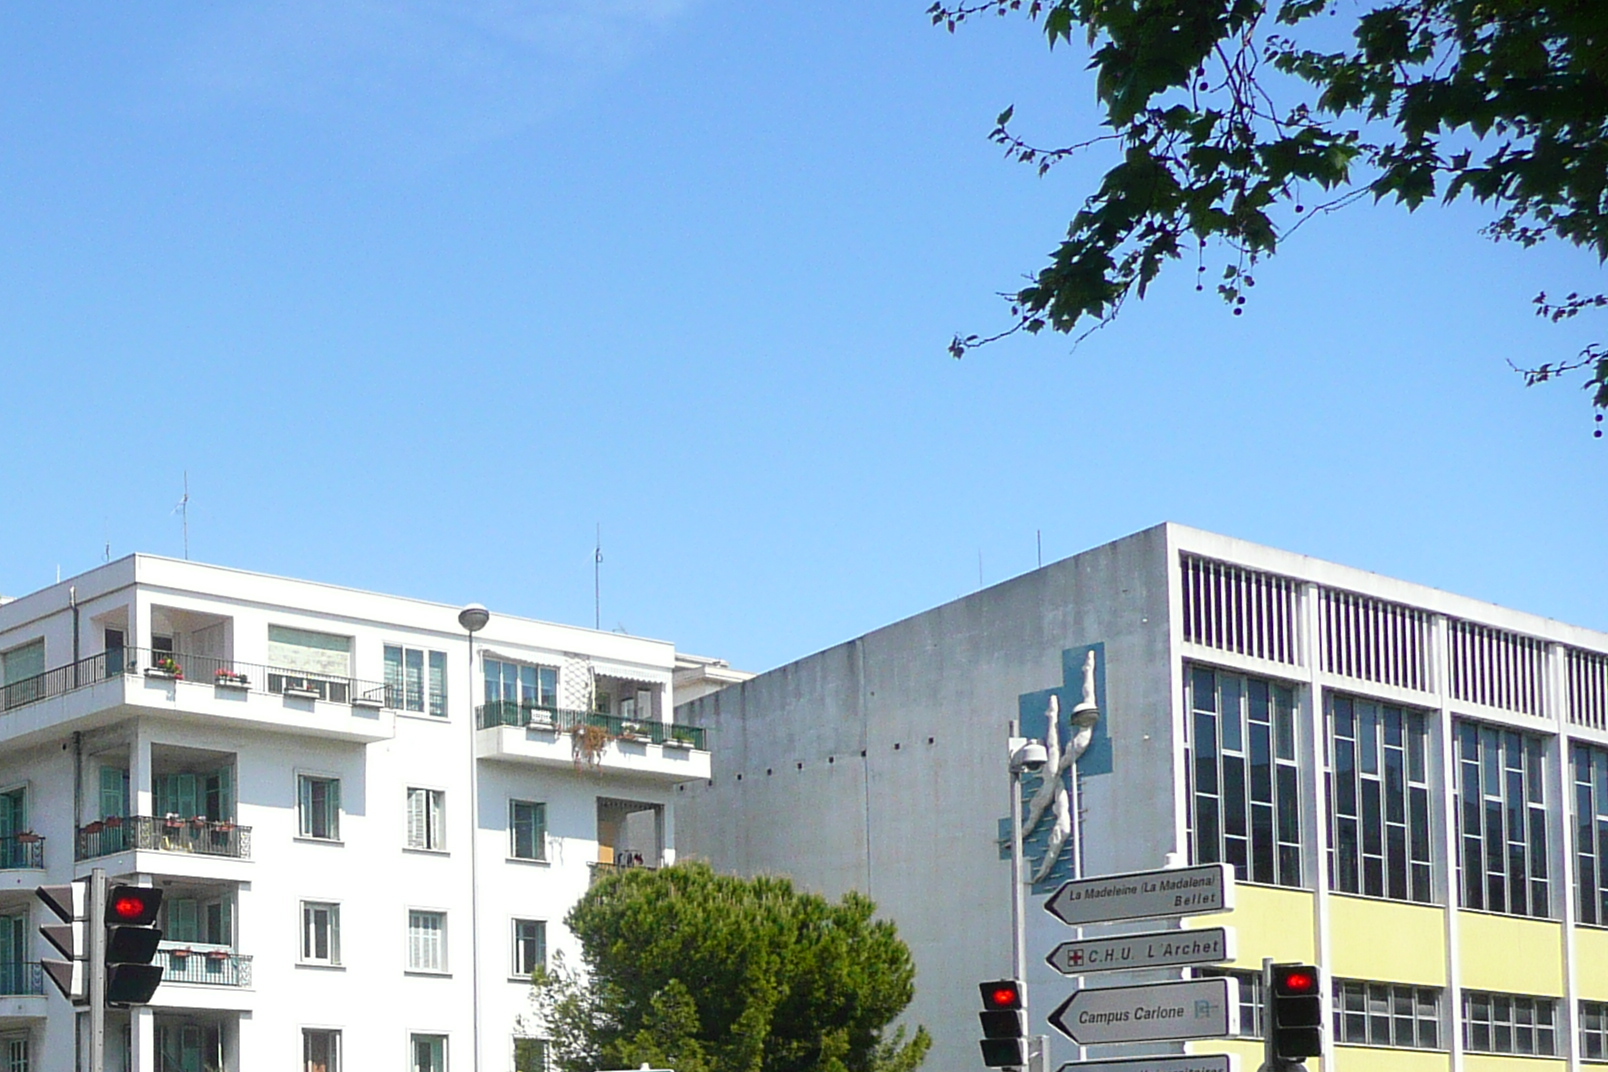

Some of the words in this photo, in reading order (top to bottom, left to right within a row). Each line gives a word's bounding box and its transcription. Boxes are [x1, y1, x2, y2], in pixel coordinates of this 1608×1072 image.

[1069, 889, 1082, 901] La
[1084, 885, 1138, 900] Madeleine
[1140, 881, 1157, 894] (La
[1159, 874, 1216, 892] Madalena)
[1174, 893, 1216, 907] Bellet
[1088, 946, 1135, 963] C.H.U.
[1079, 1009, 1130, 1025] Campus
[1134, 1005, 1185, 1020] Carlone
